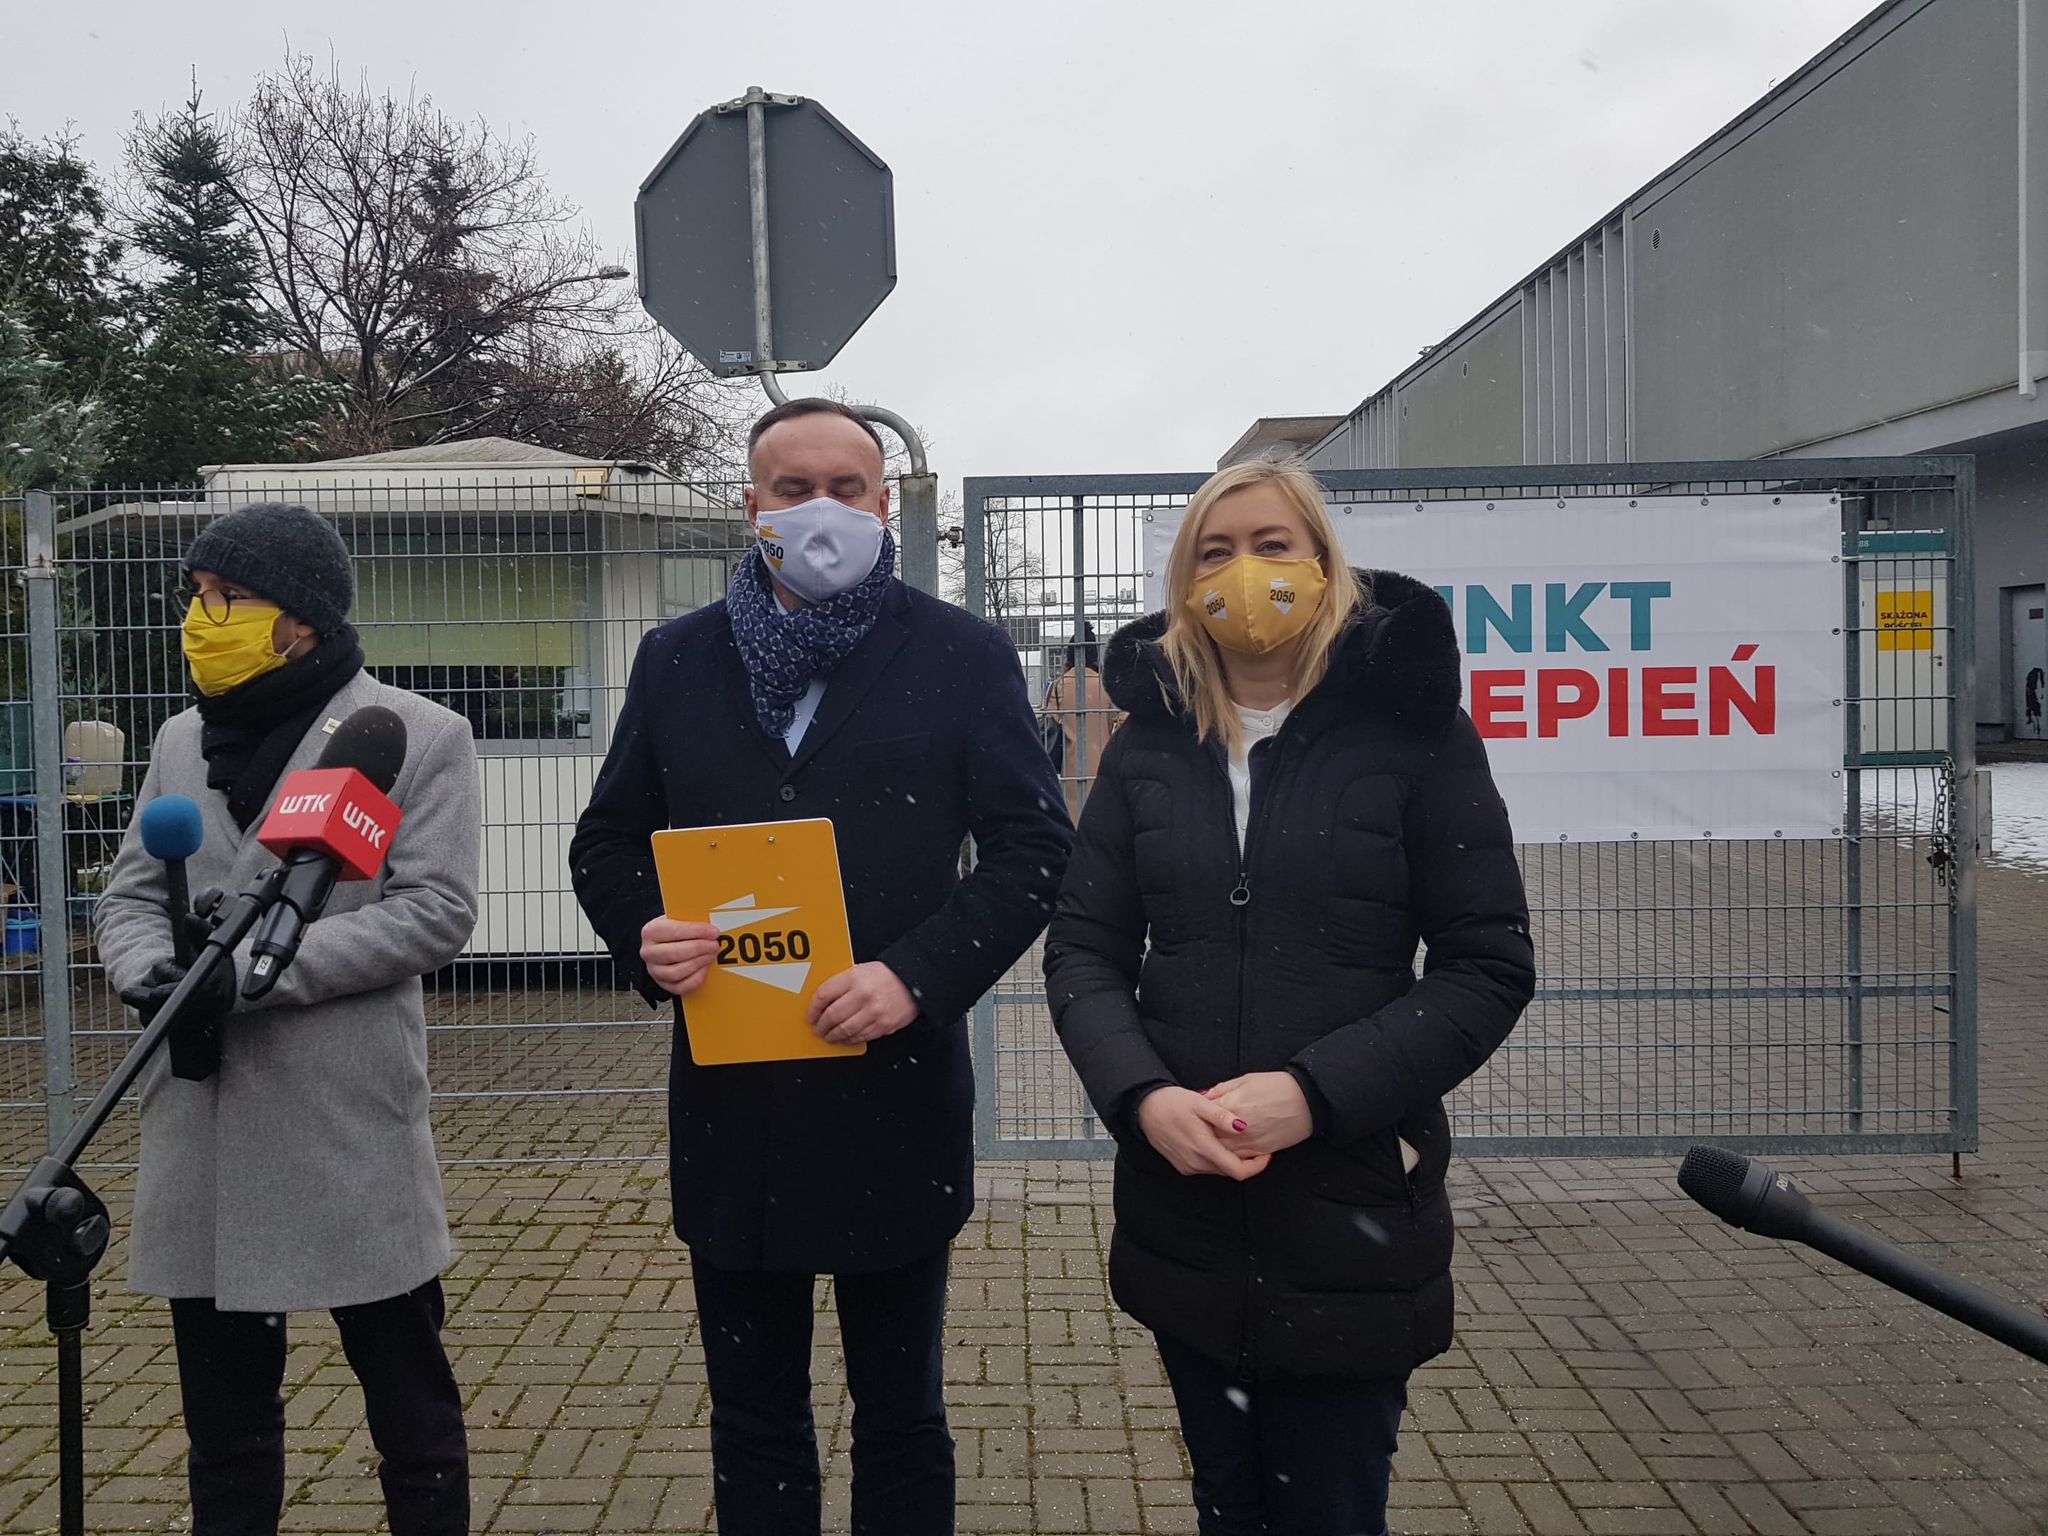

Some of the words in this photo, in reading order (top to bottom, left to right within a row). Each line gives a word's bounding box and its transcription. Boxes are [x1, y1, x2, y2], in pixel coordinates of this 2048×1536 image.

[1206, 597, 1225, 616] 2050
[1269, 589, 1296, 603] 2050
[1434, 581, 1672, 654] NKT
[717, 929, 811, 966] 2050
